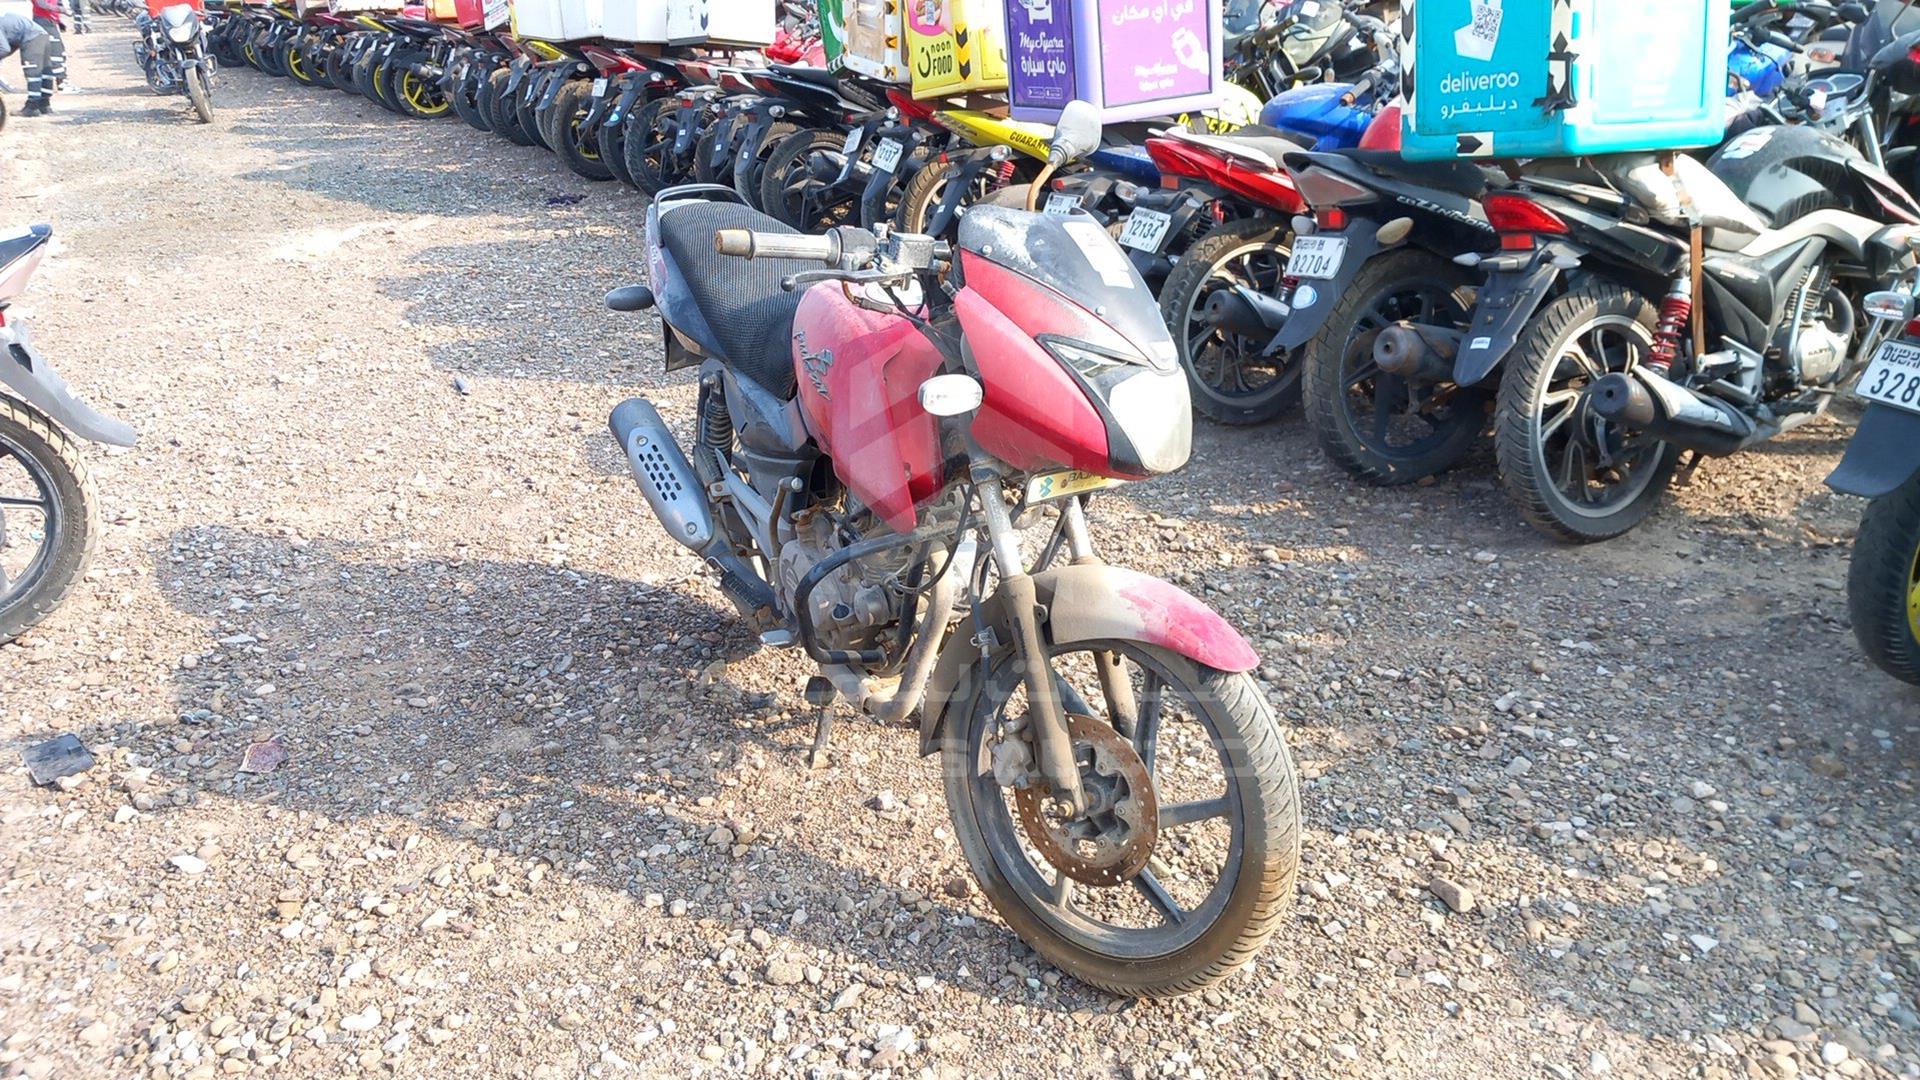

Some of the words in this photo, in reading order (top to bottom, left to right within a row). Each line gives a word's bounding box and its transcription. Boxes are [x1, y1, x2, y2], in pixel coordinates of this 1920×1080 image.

[1112, 3, 1150, 26] مكان
[931, 41, 951, 53] noon
[1019, 32, 1064, 53] MySyara
[933, 55, 952, 76] FOOD
[1021, 56, 1045, 77] سيارة
[1047, 57, 1066, 77] ماي
[1440, 71, 1520, 93] deliveroo
[1440, 94, 1518, 119] ديليفرو
[1128, 219, 1161, 240] 12134
[1292, 254, 1331, 274] 82704
[1870, 368, 1920, 407] 328
